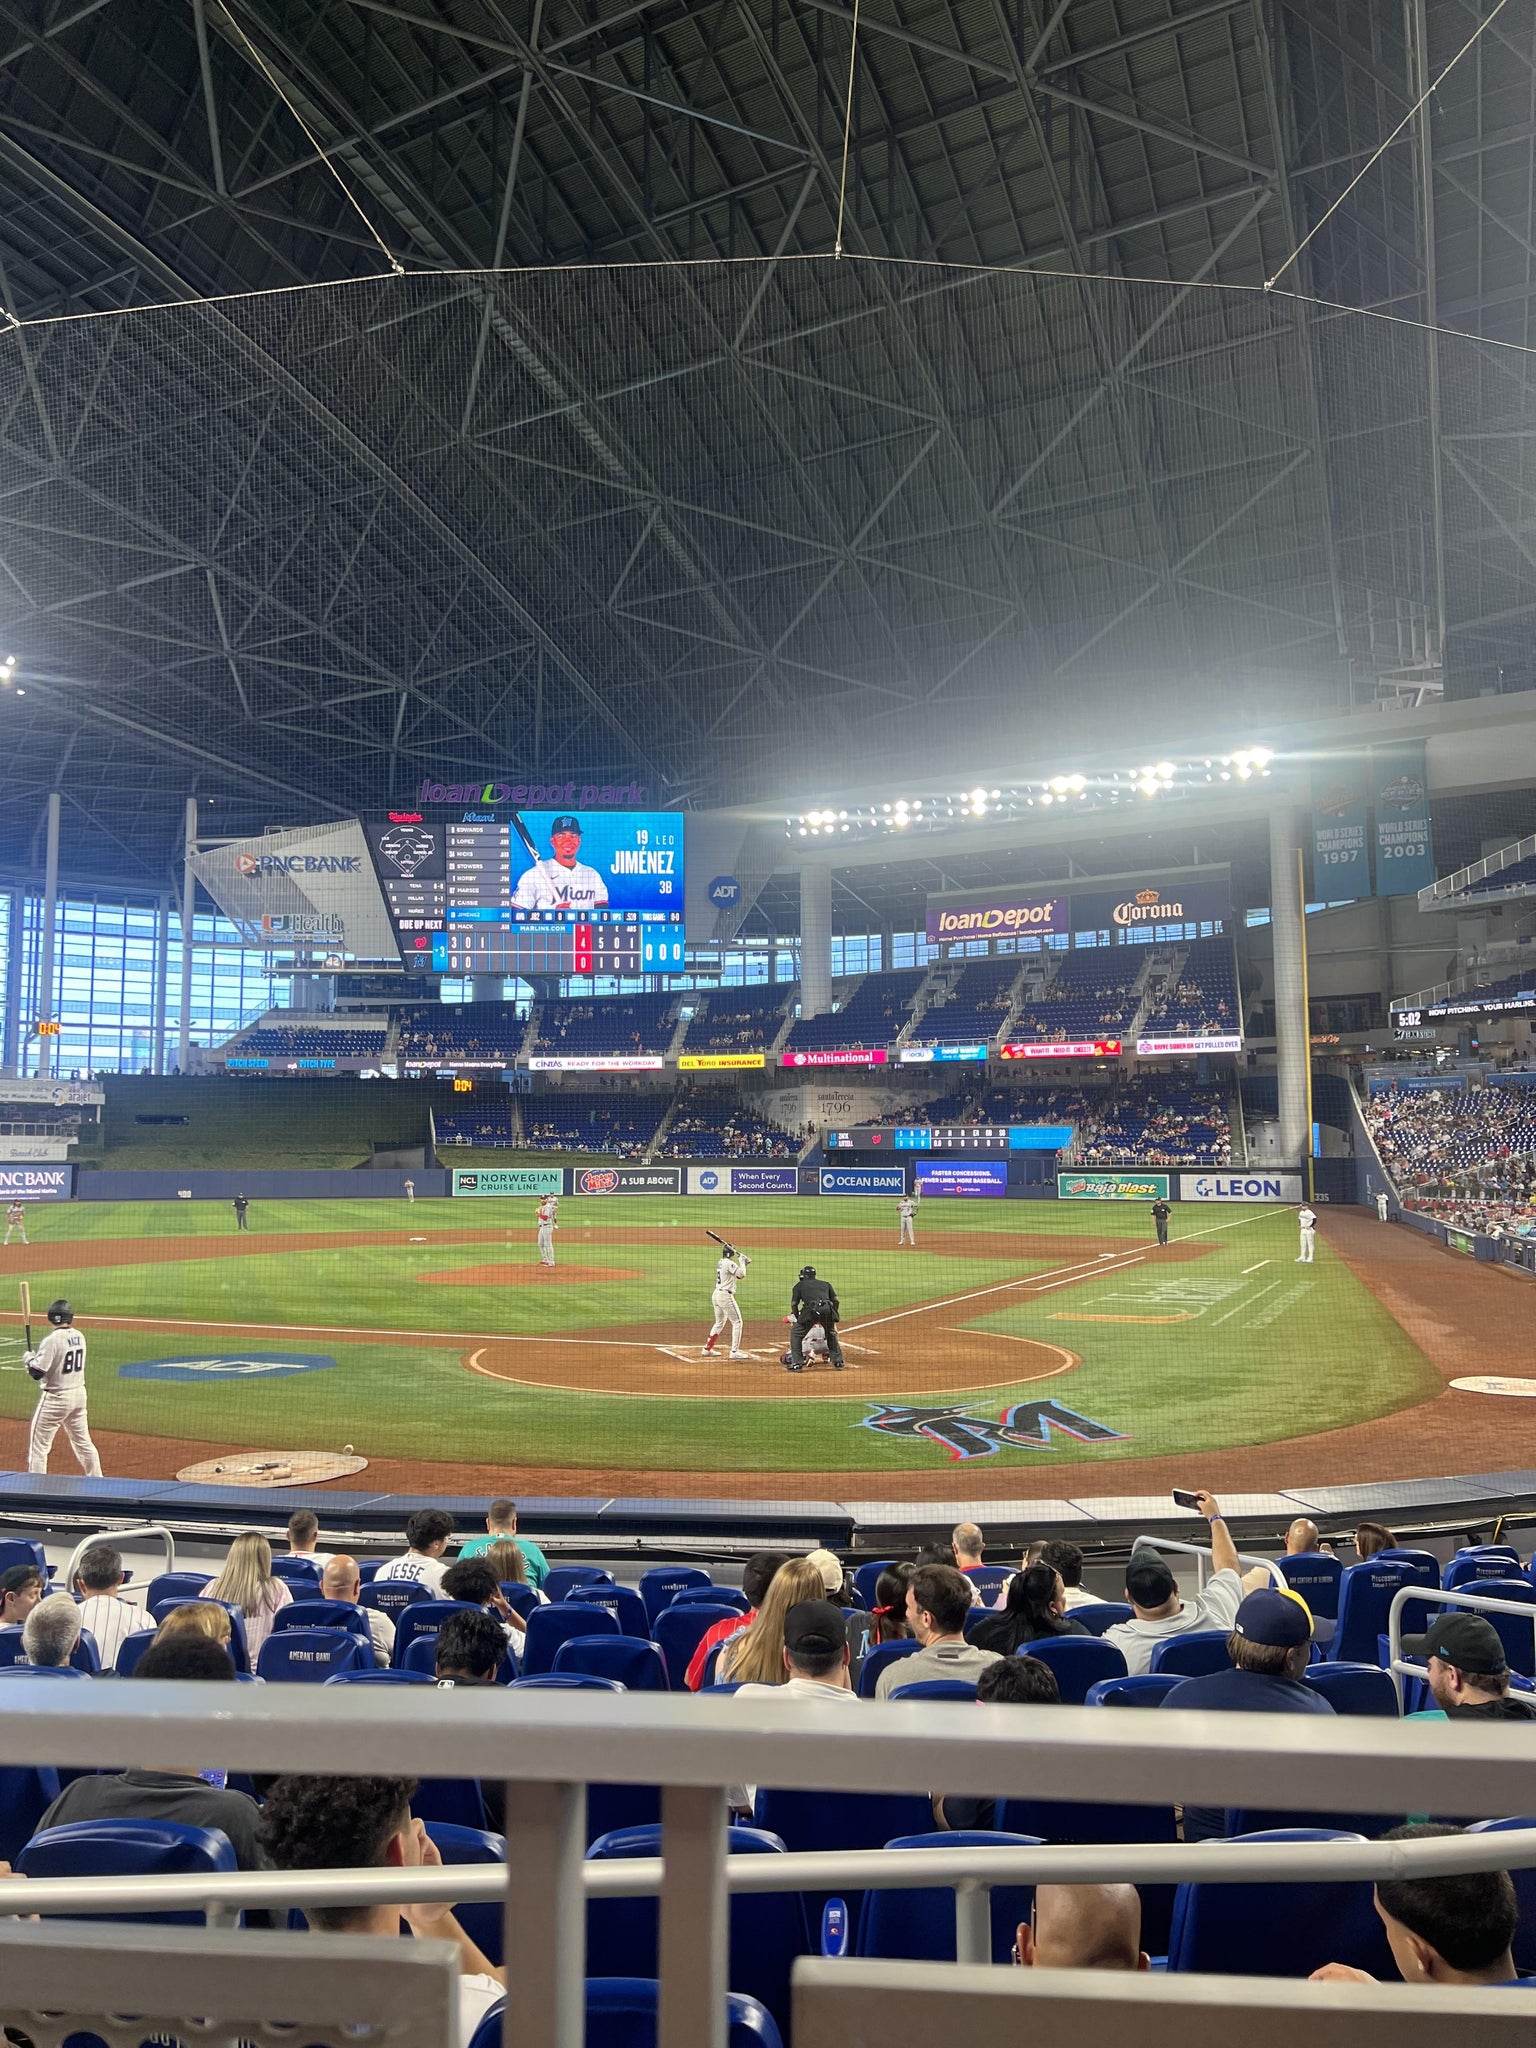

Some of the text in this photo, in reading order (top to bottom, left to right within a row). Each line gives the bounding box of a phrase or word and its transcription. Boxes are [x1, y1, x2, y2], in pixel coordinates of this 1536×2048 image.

[420, 779, 647, 809] loanDepot park
[1316, 826, 1363, 840] WORLD SERIES
[1379, 820, 1427, 833] WORLD SERIES
[636, 830, 675, 845] 19 LEO
[1379, 831, 1428, 845] CHAMPIONS
[1317, 838, 1363, 852] CHAMPIONS
[1384, 844, 1425, 858] 2003
[260, 856, 359, 872] PNC BANK
[611, 846, 675, 874] JIMÉNEZ
[1323, 850, 1358, 865] 1997
[659, 881, 672, 894] 3B
[713, 886, 737, 898] ADT
[939, 903, 1053, 931] loanDepot
[1113, 902, 1183, 926] Corona
[399, 920, 443, 930] DUE UP NEXT
[451, 936, 634, 949] 3 0 1 4 5 0 1
[440, 945, 446, 958] 3
[646, 944, 680, 960] 0 0 0
[326, 957, 339, 967] 42
[451, 956, 634, 968] 0 0 0 1 0 1
[1399, 1012, 1421, 1026] 5:02
[1447, 1006, 1480, 1014] PITCHING.
[1483, 1003, 1503, 1011] YOUR
[1504, 1000, 1536, 1009] MARLINS.
[38, 1022, 61, 1034] 0:04
[228, 1059, 269, 1068] PITCH SPEED
[300, 1060, 335, 1068] PITCH TYPE
[405, 1060, 441, 1069] loanDepot
[807, 1052, 873, 1064] Multinational
[454, 1080, 472, 1091] 0:04
[822, 1101, 850, 1116] 1796
[33, 1148, 48, 1157] Club
[25, 1172, 65, 1186] BANK
[481, 1174, 558, 1182] NORWEGIAN
[647, 1177, 673, 1185] ABOVE
[761, 1173, 780, 1182] Every
[836, 1177, 901, 1187] OCEAN BANK
[1085, 1182, 1157, 1194] Baja Blast
[1216, 1179, 1281, 1197] LEON
[1314, 1193, 1329, 1201] 335
[62, 1349, 83, 1375] 80
[387, 1563, 425, 1581] JESSE
[289, 1651, 314, 1661] AMERANT
